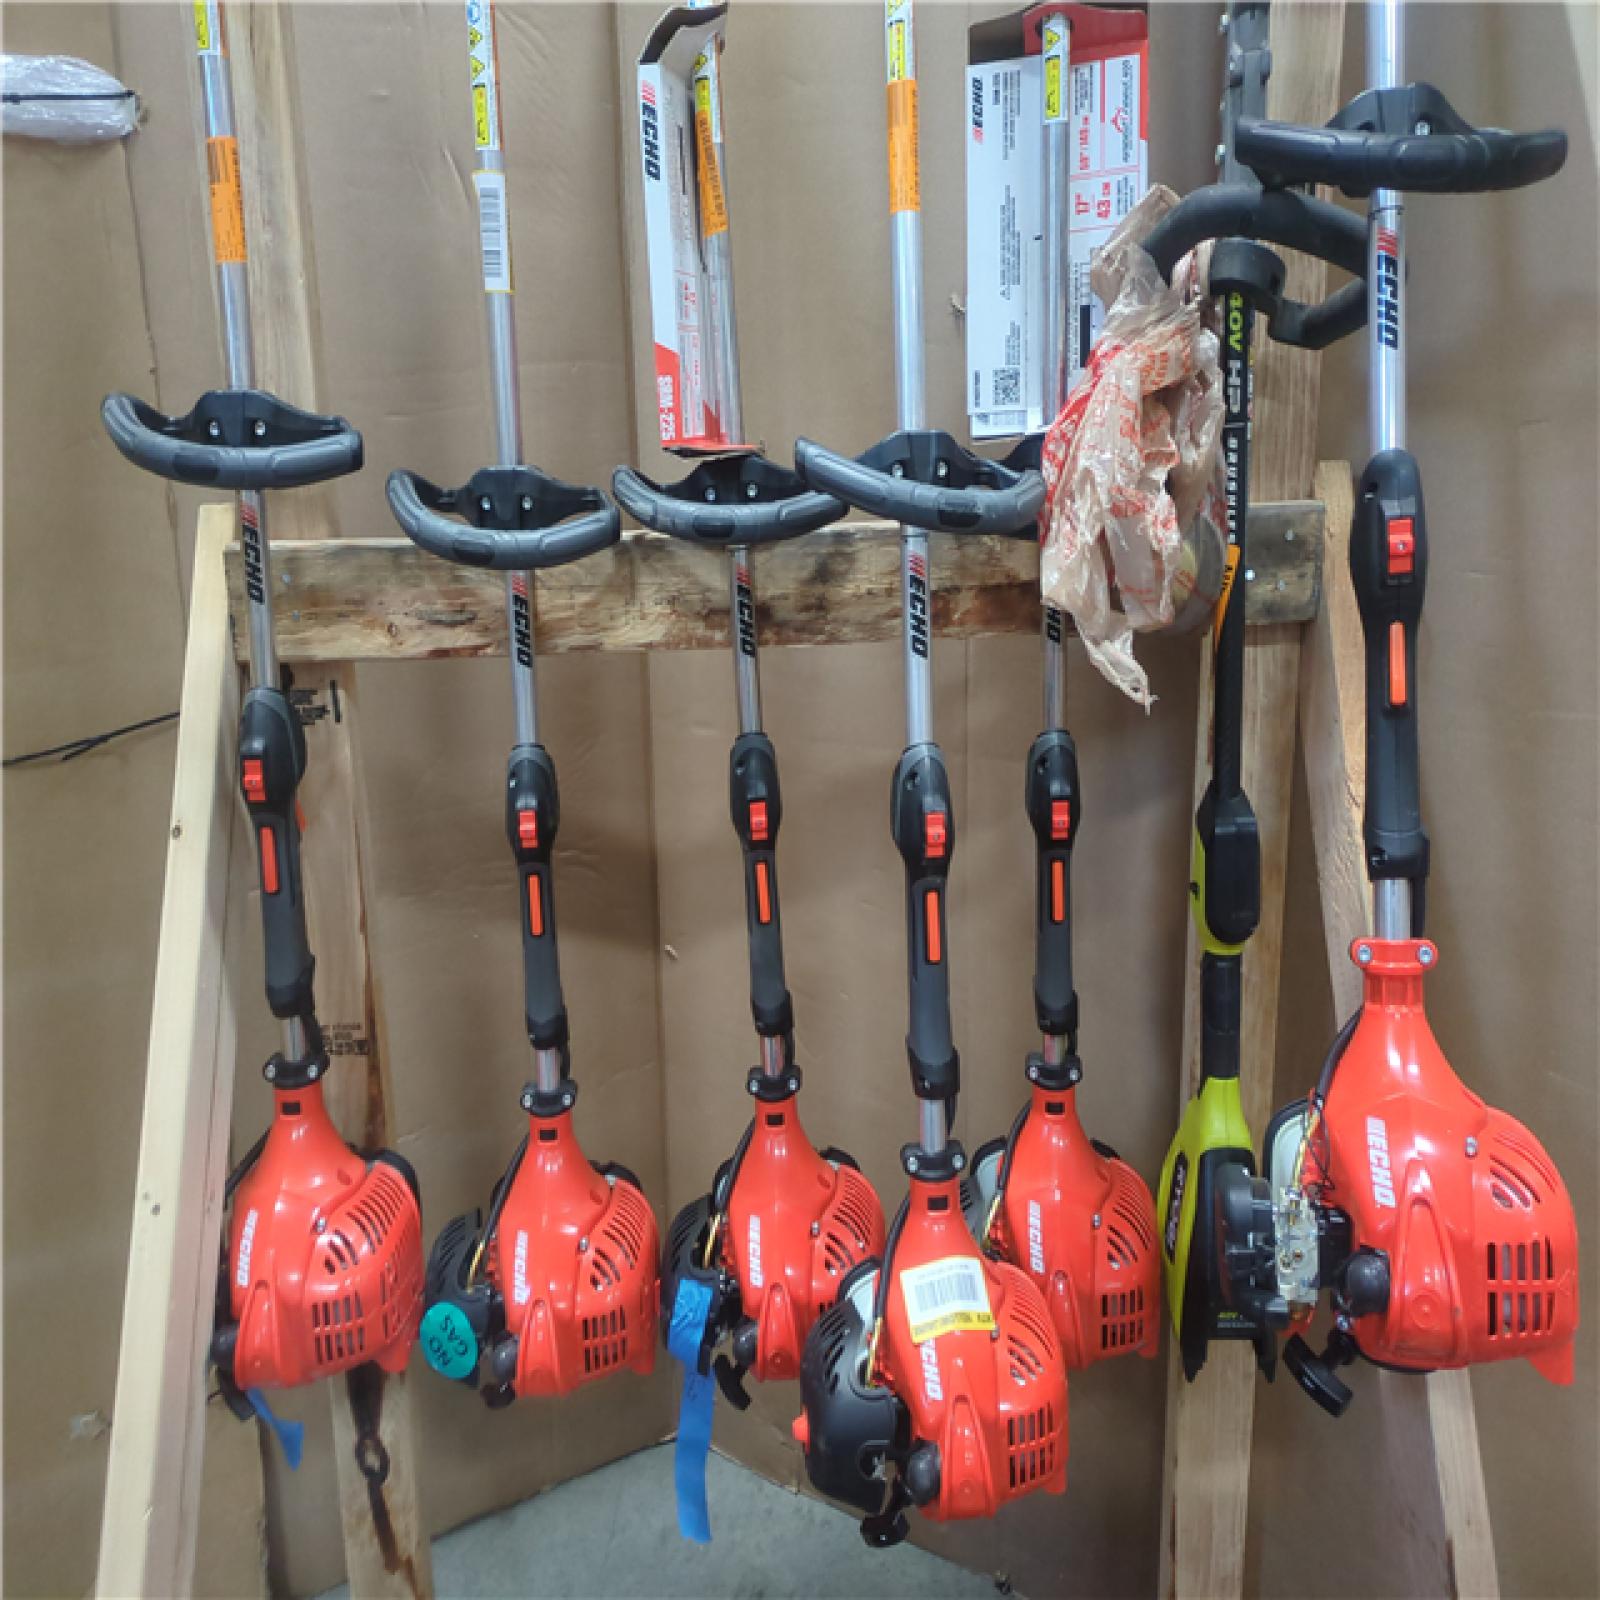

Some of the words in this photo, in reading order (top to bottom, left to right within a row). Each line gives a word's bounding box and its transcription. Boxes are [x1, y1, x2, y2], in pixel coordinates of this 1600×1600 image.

[972, 77, 983, 128] ECHO
[642, 102, 660, 181] ECHO
[1229, 293, 1243, 352] 40V
[1377, 254, 1398, 350] ECHO
[1227, 360, 1241, 413] HP
[1226, 437, 1238, 544] BRUSHLES
[242, 524, 263, 605] ECHO
[512, 595, 533, 667] ECHO
[737, 585, 756, 657] ECHO
[909, 575, 928, 659] ECHO
[1047, 607, 1061, 643] HO
[1367, 1116, 1396, 1208] ECHO
[236, 1209, 258, 1287] ECHO
[514, 1230, 530, 1305] ECHO
[749, 1216, 763, 1288] ECHO
[1029, 1200, 1046, 1275] ECHO
[429, 1336, 452, 1367] NO
[440, 1314, 468, 1356] GAS
